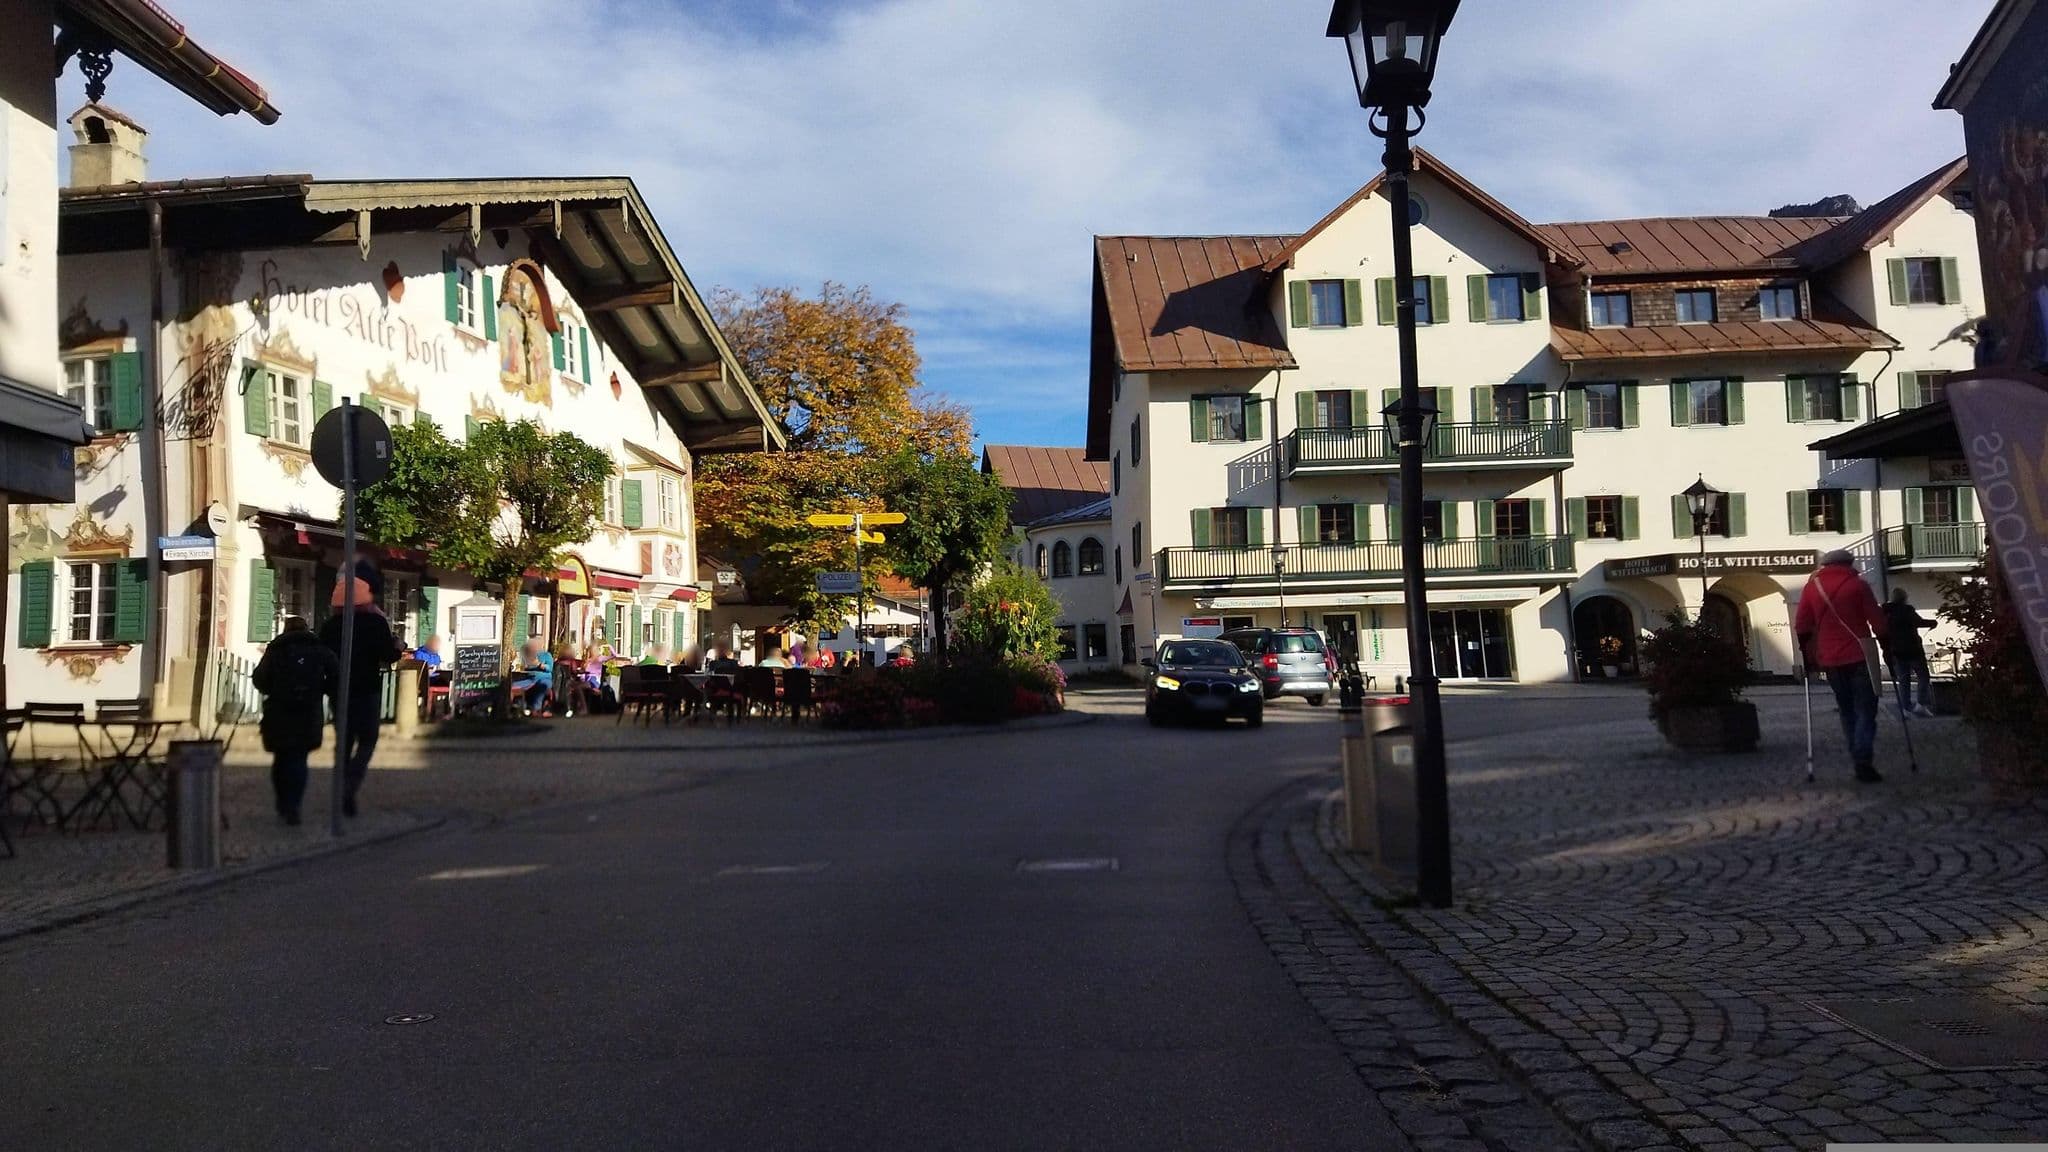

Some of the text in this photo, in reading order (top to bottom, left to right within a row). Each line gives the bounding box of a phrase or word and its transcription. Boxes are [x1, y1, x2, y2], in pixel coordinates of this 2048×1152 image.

[262, 257, 331, 327] Hotel
[339, 293, 396, 352] Alte
[1724, 555, 1815, 567] WITTELSBACH
[823, 573, 851, 581] POLIZEI
